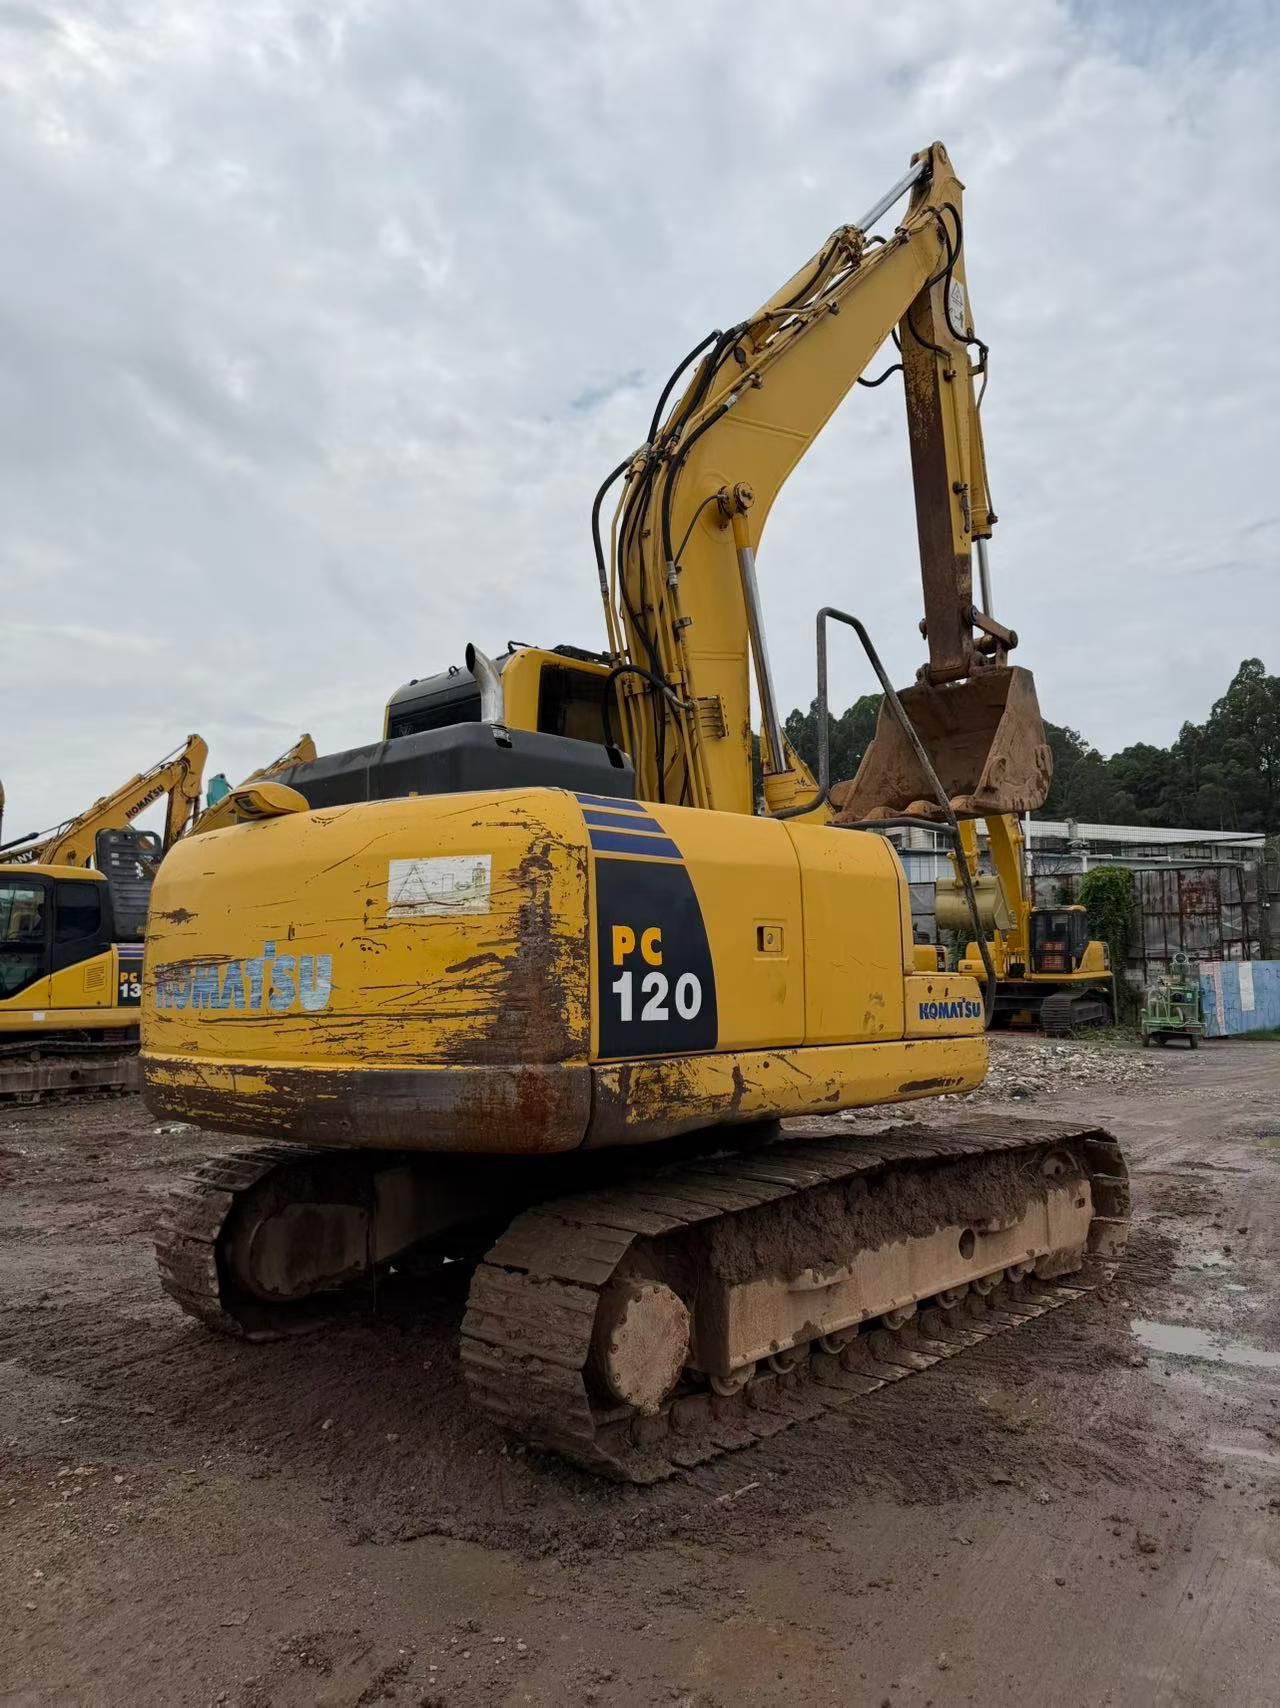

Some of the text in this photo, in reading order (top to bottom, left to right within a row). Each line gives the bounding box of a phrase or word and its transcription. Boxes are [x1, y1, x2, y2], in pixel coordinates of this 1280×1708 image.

[125, 784, 165, 820] KOMATSU
[611, 925, 663, 966] PC
[120, 971, 138, 983] PC
[120, 983, 142, 998] 13
[612, 971, 702, 1022] 120
[919, 998, 981, 1020] KOMATSU
